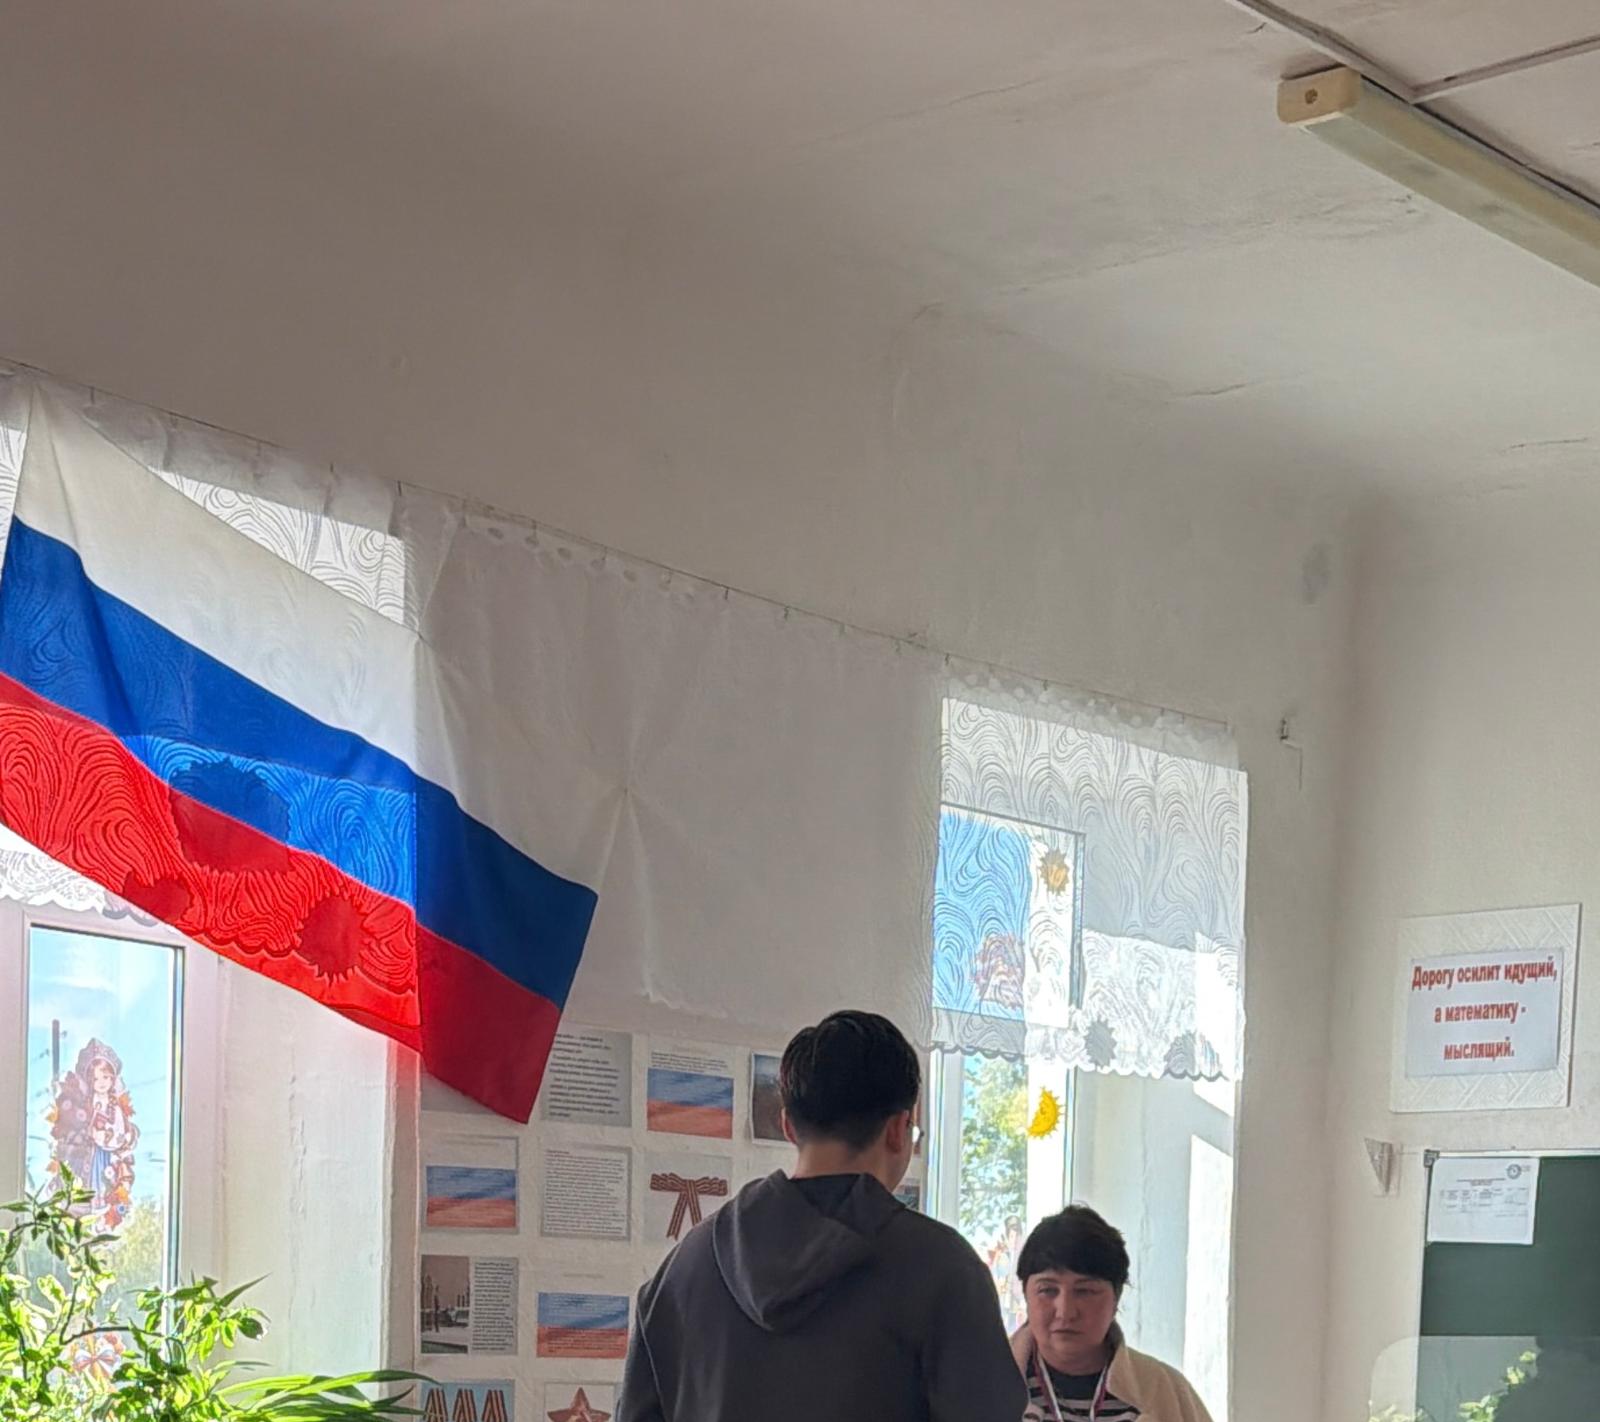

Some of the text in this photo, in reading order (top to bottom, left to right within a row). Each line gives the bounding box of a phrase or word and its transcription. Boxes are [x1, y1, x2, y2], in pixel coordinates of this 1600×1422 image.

[1411, 955, 1557, 991] Дорогу осилит идущий,
[1434, 1005, 1441, 1023] а
[1445, 1001, 1518, 1024] математику
[1443, 1036, 1515, 1062] мыслящий.
